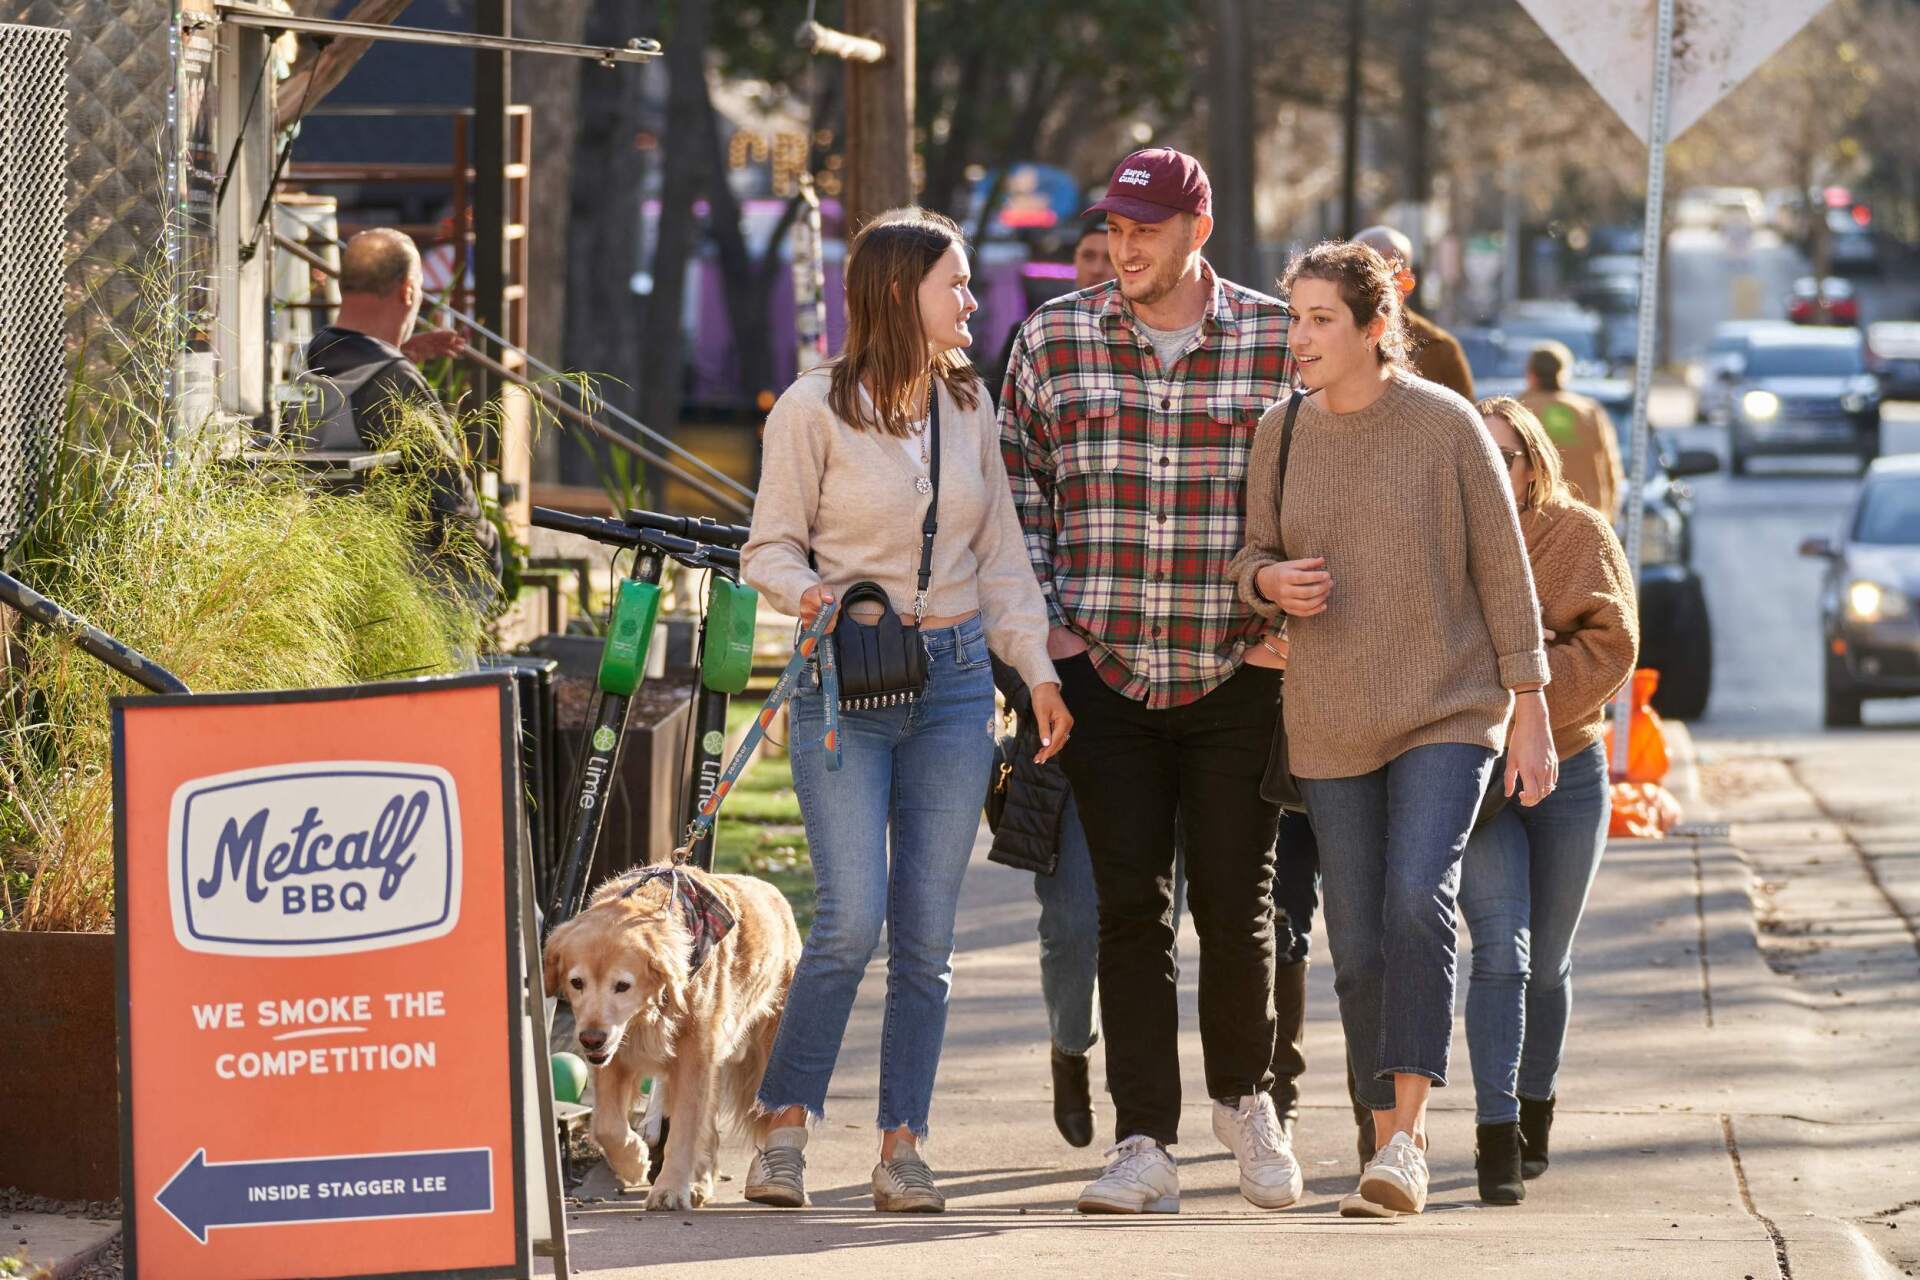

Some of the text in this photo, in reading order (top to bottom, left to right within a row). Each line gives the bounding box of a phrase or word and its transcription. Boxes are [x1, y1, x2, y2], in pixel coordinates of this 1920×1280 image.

[580, 756, 608, 809] Lime
[198, 790, 430, 903] Metcalf
[282, 881, 368, 915] BBQ
[192, 991, 446, 1029] WE SMOKE THE
[215, 1042, 436, 1079] COMPETITION
[248, 1176, 447, 1202] INSIDE STAGGER LEE
